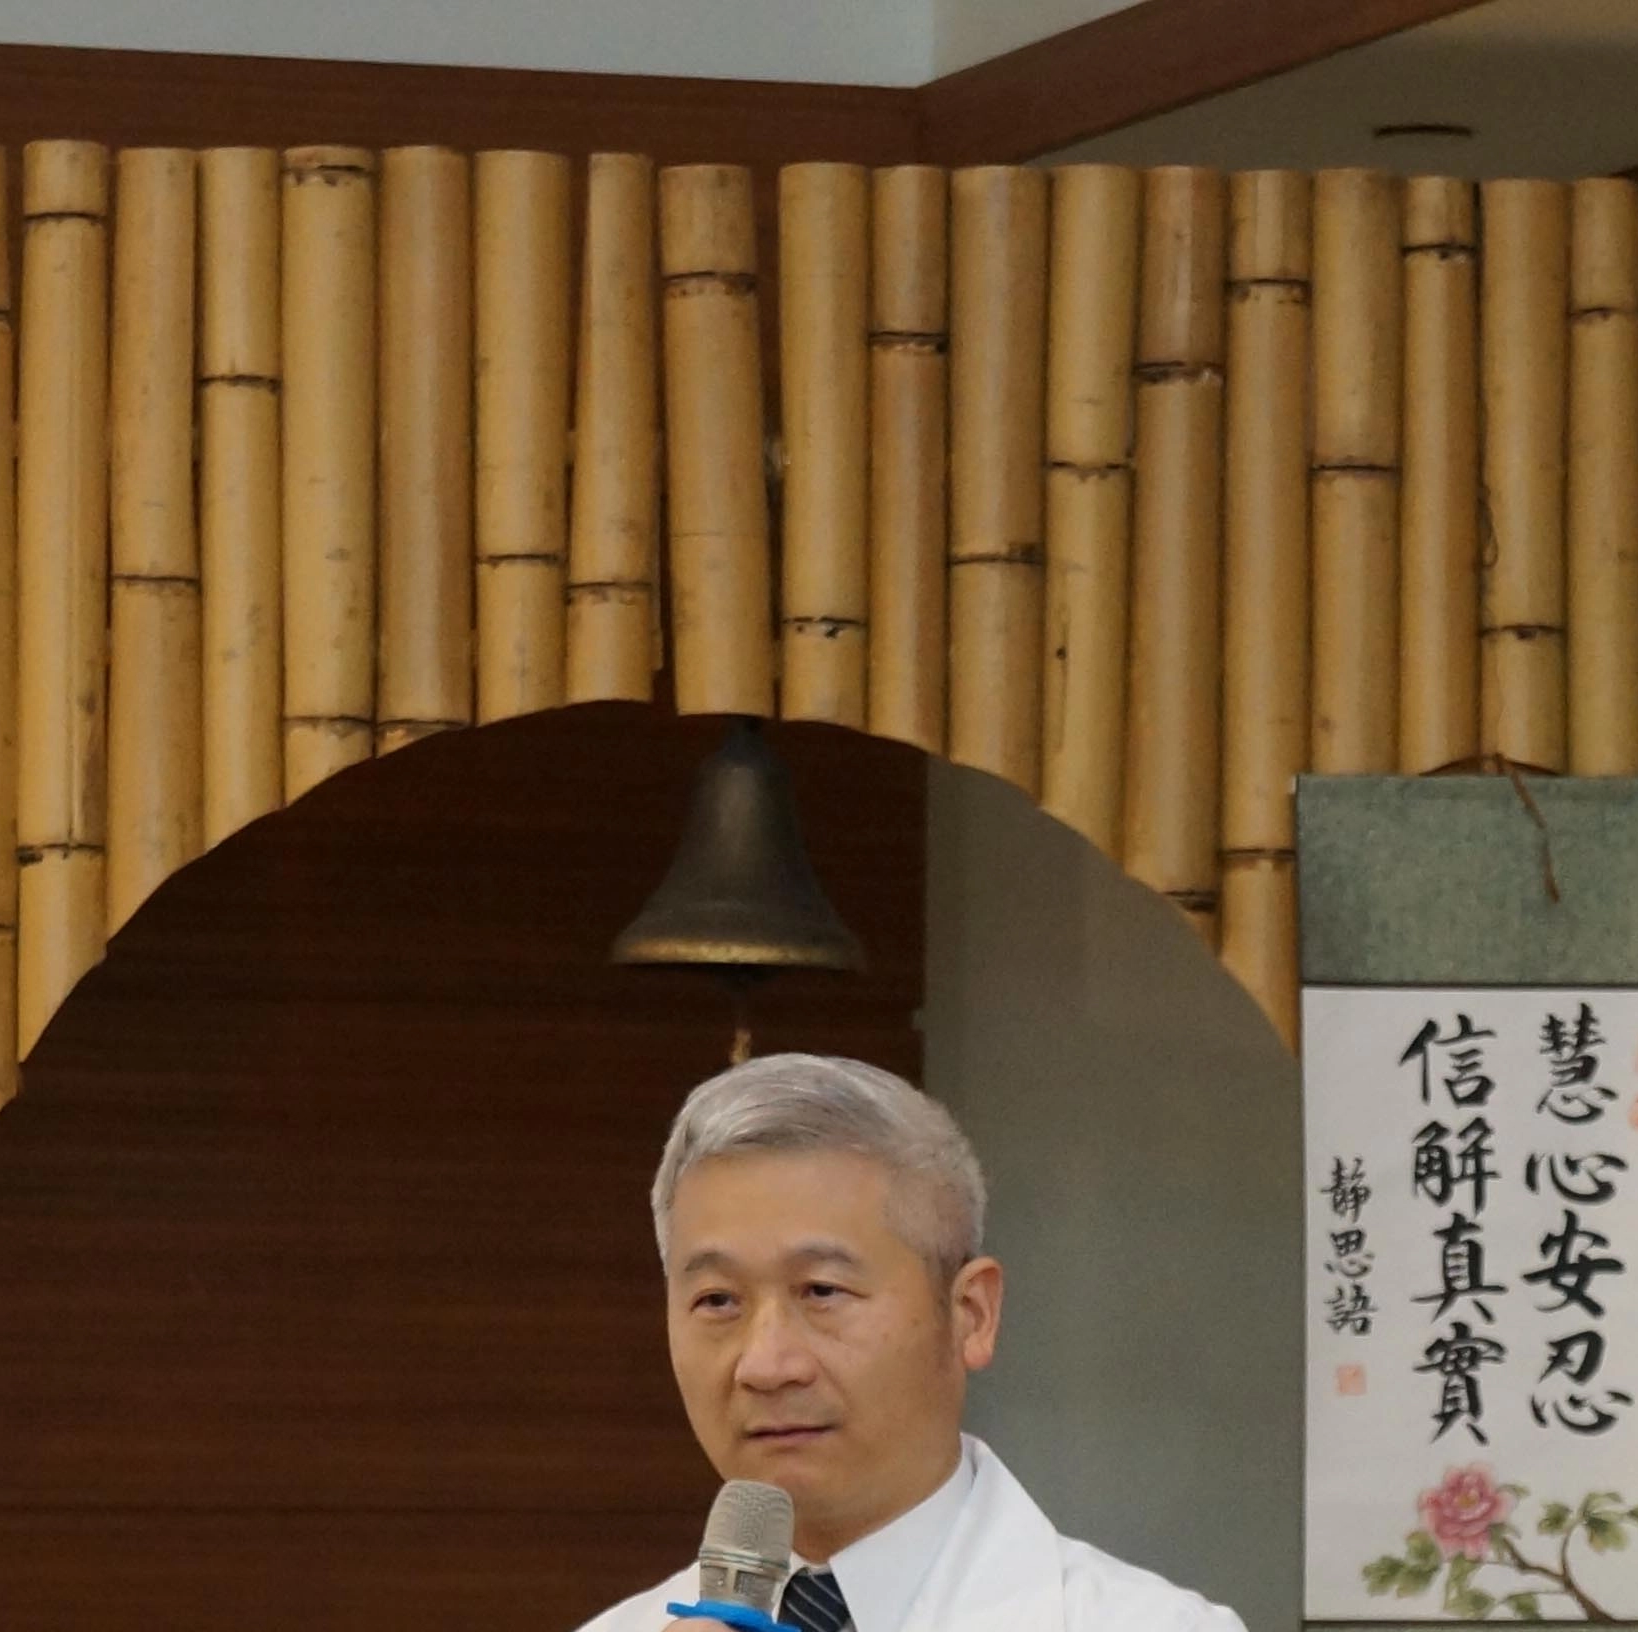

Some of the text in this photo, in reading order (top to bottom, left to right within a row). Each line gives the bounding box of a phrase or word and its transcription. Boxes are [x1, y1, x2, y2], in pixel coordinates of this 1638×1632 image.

[1320, 1156, 1378, 1337] 靜思語
[1398, 1013, 1507, 1446] 信解真實
[1523, 1002, 1633, 1435] 慧心安忍
